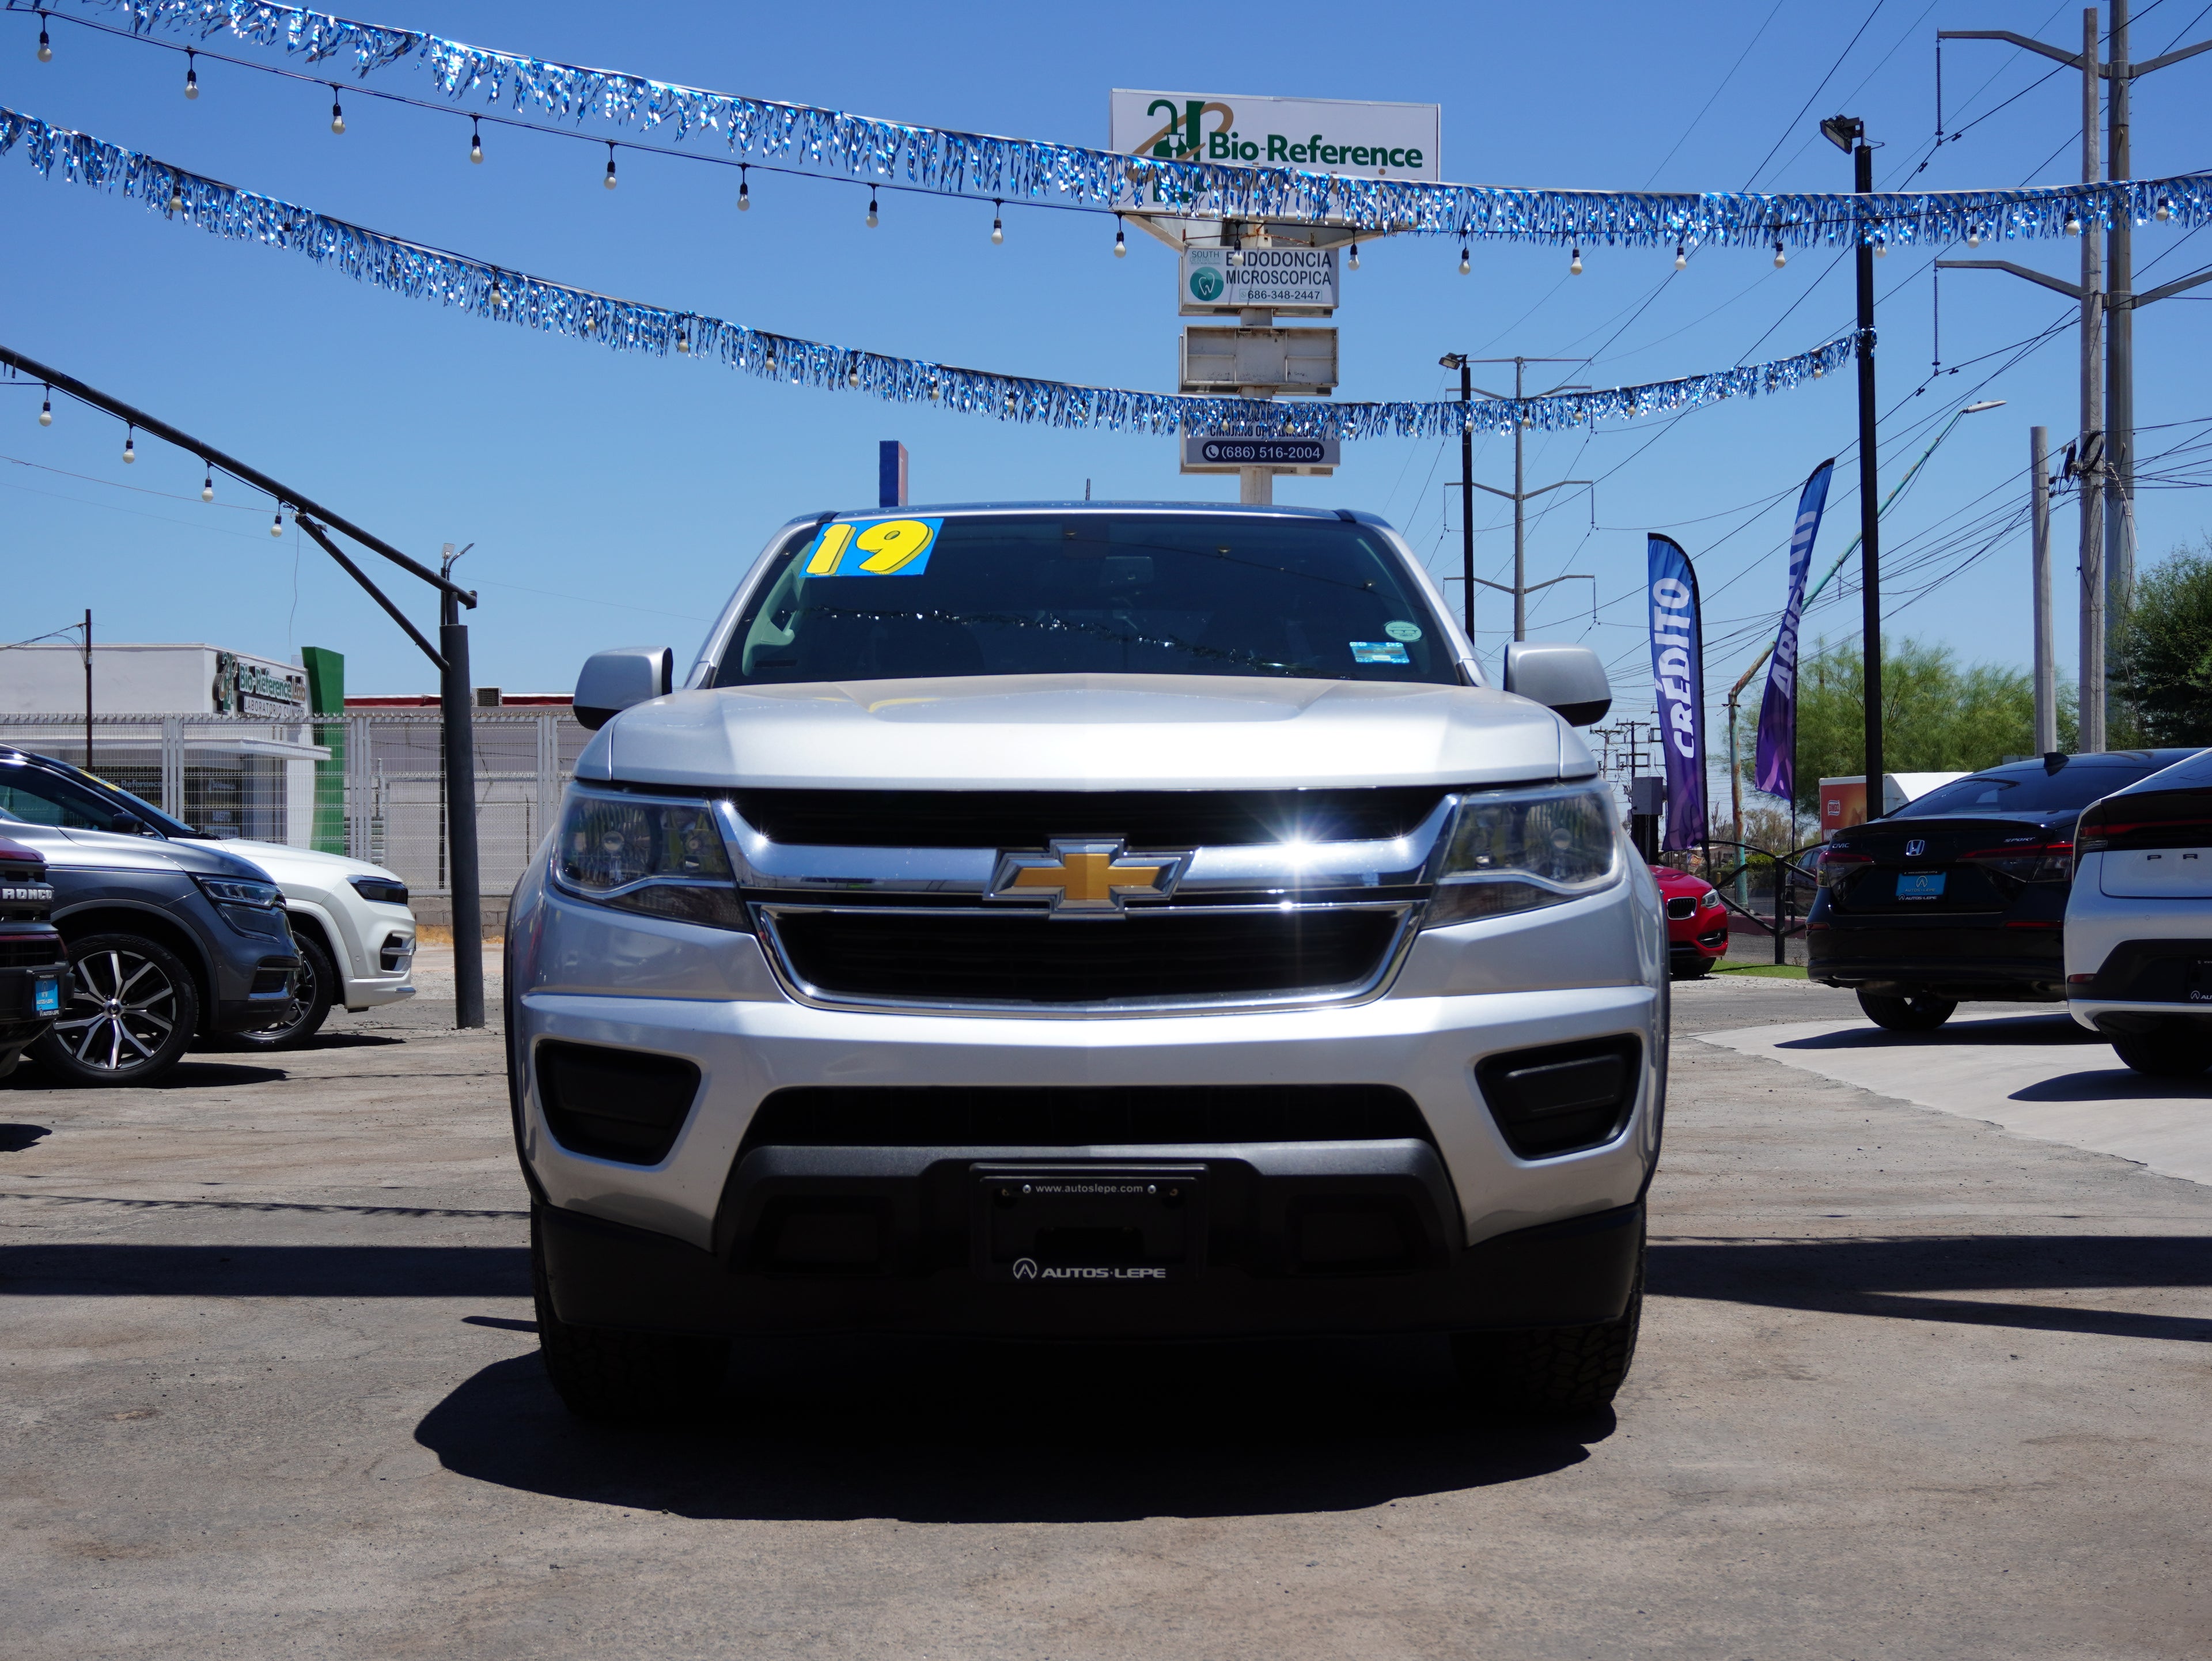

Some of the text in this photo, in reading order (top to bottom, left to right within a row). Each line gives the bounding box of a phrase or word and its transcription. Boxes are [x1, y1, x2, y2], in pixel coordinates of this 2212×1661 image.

[1209, 131, 1423, 168] Bio-Reference
[1191, 250, 1219, 258] SOUTH
[1226, 252, 1332, 268] ENDODONCIA
[1226, 270, 1331, 286] MICROSCOPICA
[1248, 290, 1320, 300] 686-348-2447
[1221, 446, 1321, 459] (686) 516-2004
[806, 519, 934, 575] 19
[1653, 577, 1694, 758] CRÉDITO
[239, 664, 306, 702] Bio-Reference Lab
[244, 698, 282, 716] LABORATORIO
[0, 888, 53, 900] RONCO
[1035, 1183, 1143, 1195] www.autoslepe.com
